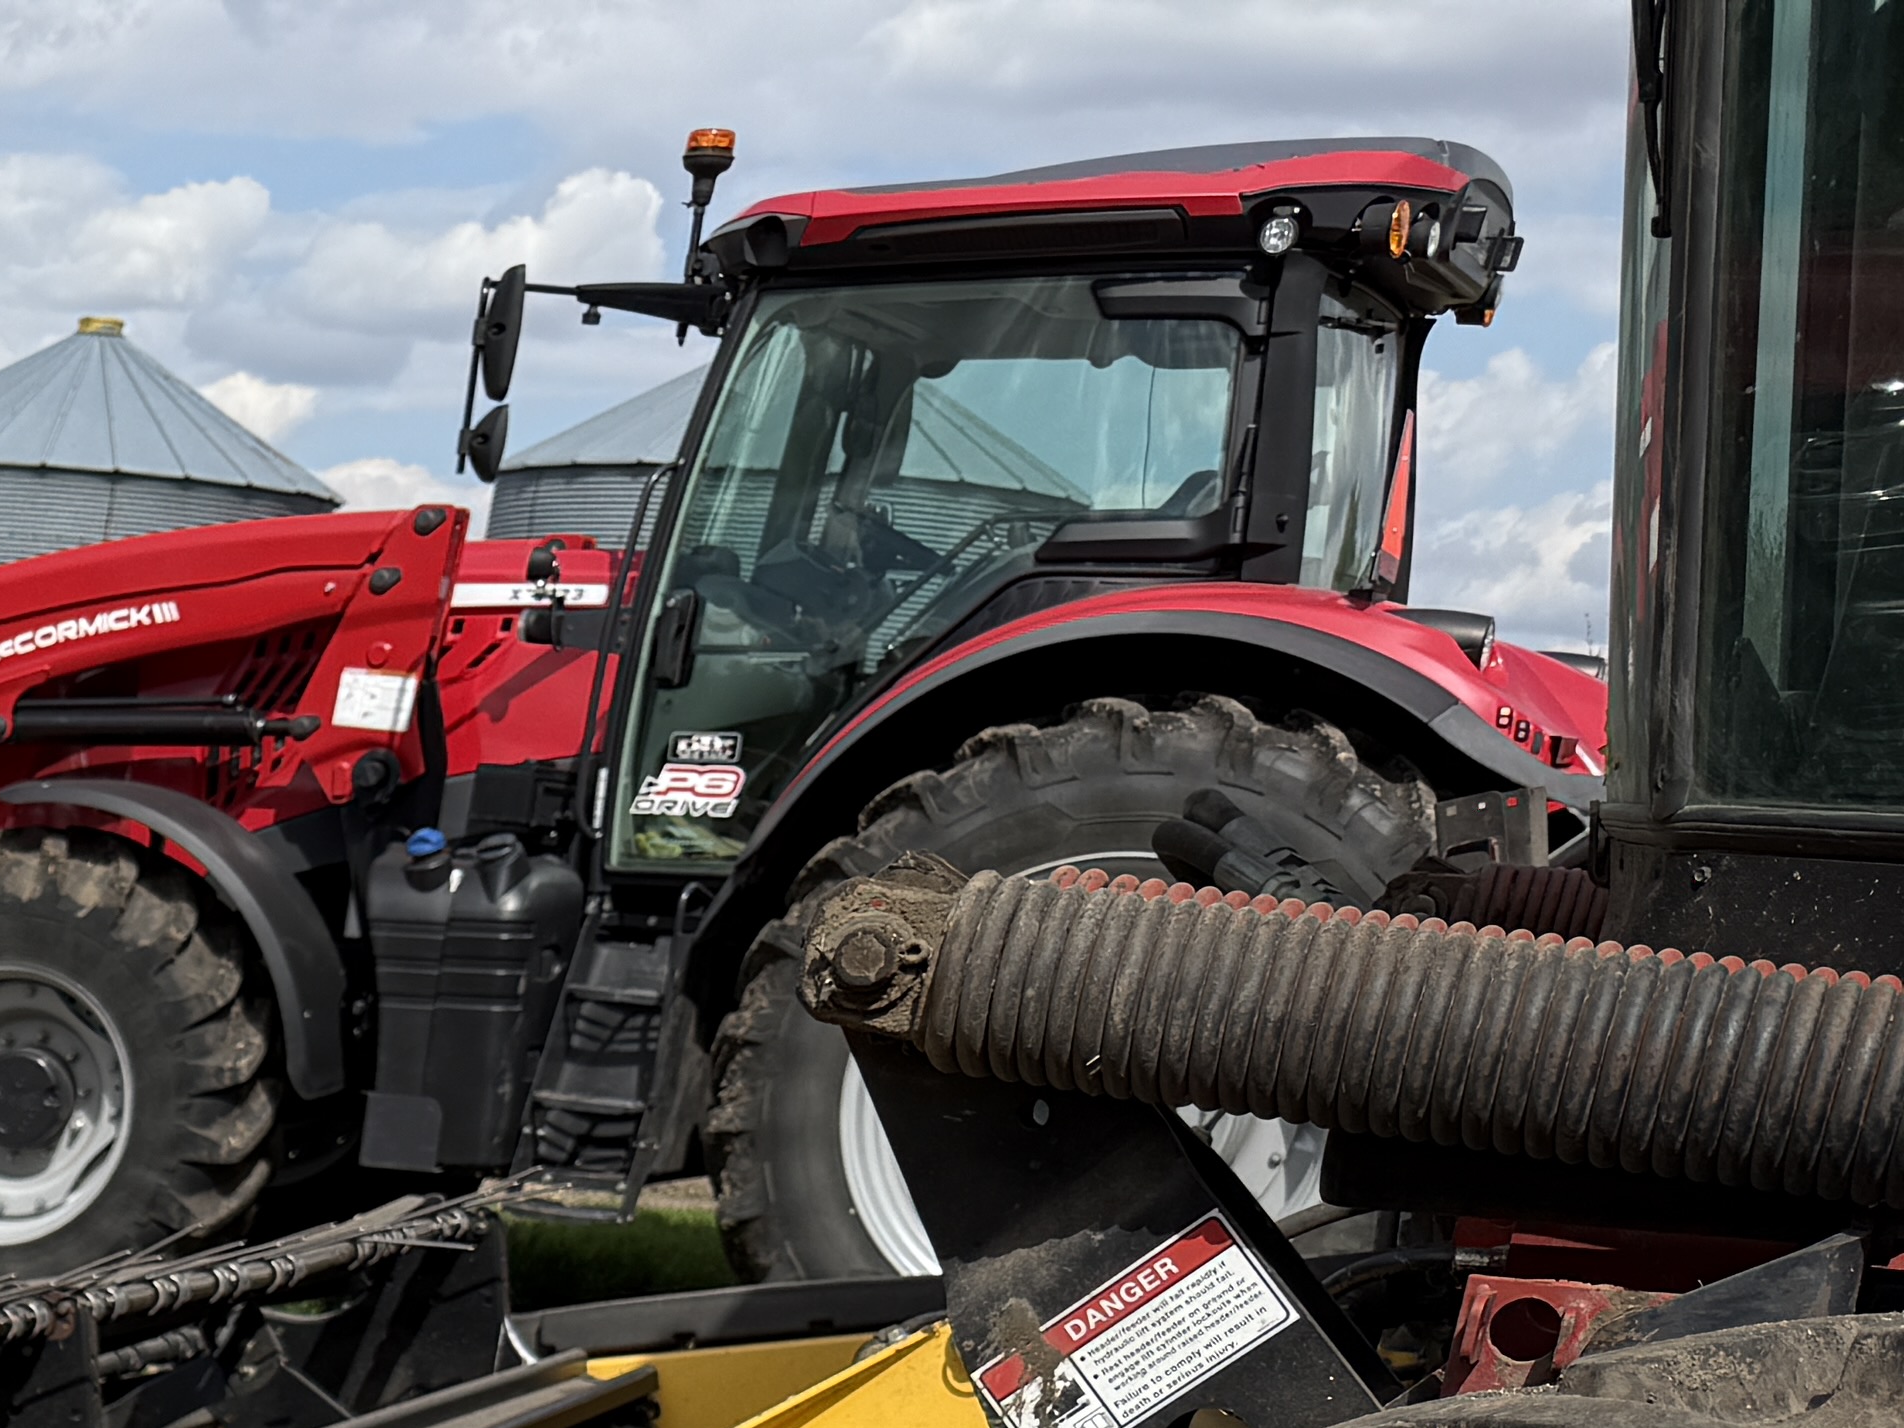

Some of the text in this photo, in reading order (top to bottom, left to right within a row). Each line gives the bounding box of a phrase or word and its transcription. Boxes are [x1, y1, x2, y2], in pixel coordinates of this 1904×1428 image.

[634, 798, 737, 817] DRIVE
[659, 769, 739, 796] P6
[1062, 1254, 1180, 1341] DANGER
[1085, 1259, 1227, 1357] Header/feeder will fall rapidly if
[1092, 1267, 1235, 1366] hydraulic lift system should fail.
[1113, 1381, 1150, 1409] Failure
[1149, 1373, 1163, 1385] to
[1162, 1347, 1203, 1378] comply
[1201, 1333, 1222, 1350] will
[1222, 1313, 1254, 1337] result
[1254, 1304, 1267, 1316] in
[1120, 1338, 1239, 1419] death or serious injury.
